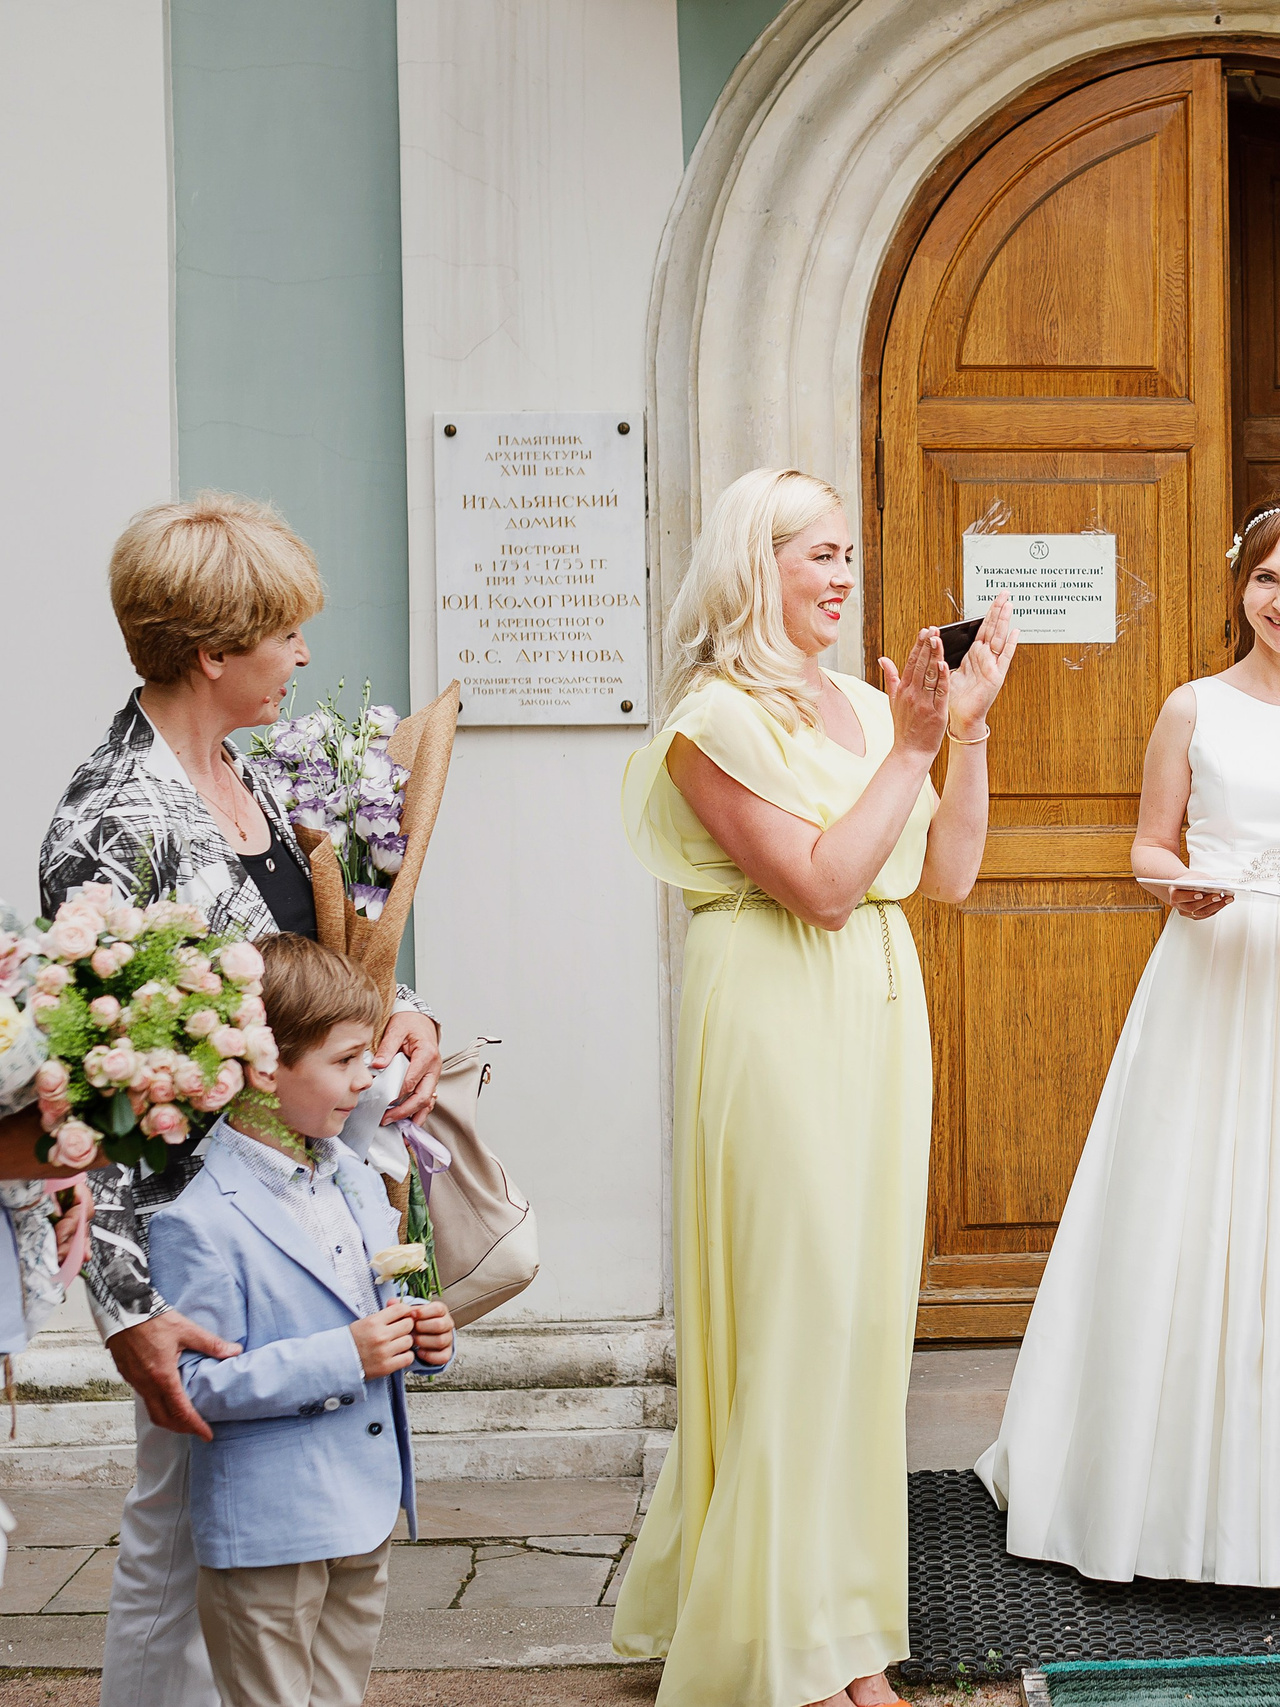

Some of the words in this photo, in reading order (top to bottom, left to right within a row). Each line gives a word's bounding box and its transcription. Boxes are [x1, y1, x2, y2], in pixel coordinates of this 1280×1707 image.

[498, 435, 583, 446] ПАМЯТНИК
[485, 450, 592, 462] АРХИТЕКТУРЫ
[501, 464, 537, 476] XVIII
[545, 466, 585, 476] ВЕКА
[462, 488, 618, 510] ИТАЛЬЯНСКИЙ
[505, 516, 576, 530] ДОМИК
[501, 544, 580, 555] ПОСТРОЕН
[975, 566, 1038, 575] Уважаемые
[1040, 566, 1103, 575] посетители!
[486, 576, 515, 586] ПРИ
[524, 574, 594, 585] УЧАСТИИ
[986, 579, 1057, 588] Итальянский
[1060, 581, 1094, 589] домик
[488, 593, 641, 609] КОЛОГРИВОВА
[1034, 594, 1102, 602] техническим
[1012, 608, 1066, 617] причинам
[479, 619, 489, 628] И
[497, 617, 604, 628] КРЕПОСТНОГО
[492, 632, 592, 642] АРХИТЕКТОРА
[516, 649, 624, 663] АРГУНОВА
[464, 677, 532, 685] ОХРАНЯЕТСЯ
[538, 676, 623, 685] ГОСУДАРСТВОМ
[518, 698, 571, 706] ЗАКОНОМ
